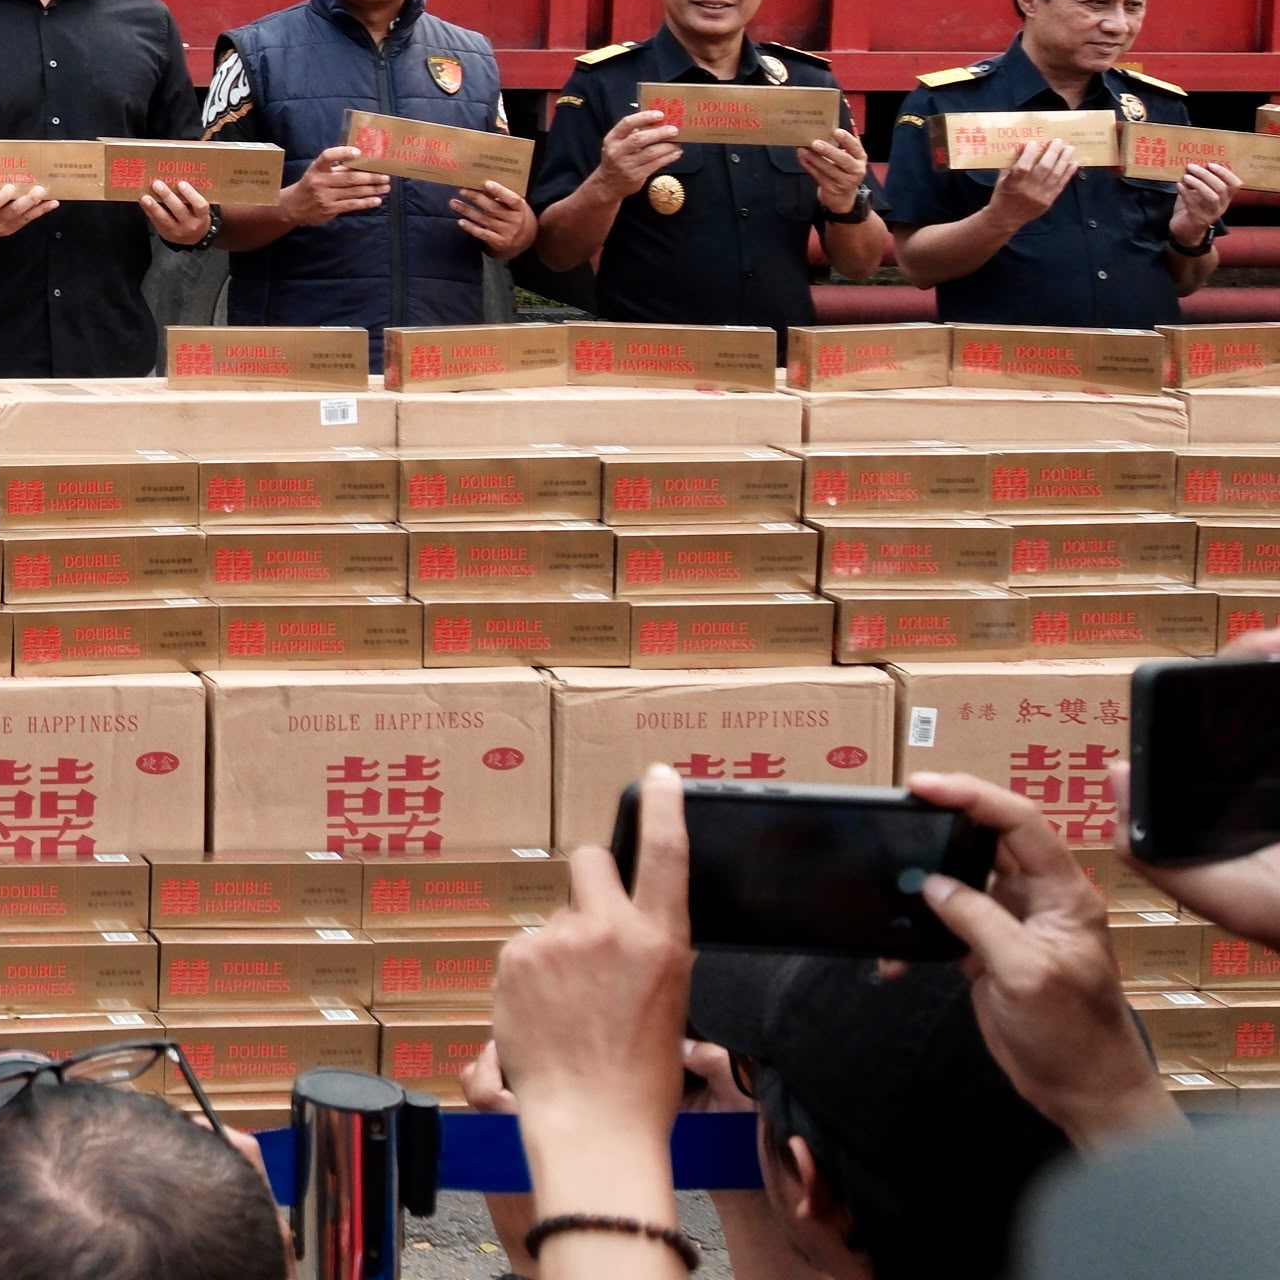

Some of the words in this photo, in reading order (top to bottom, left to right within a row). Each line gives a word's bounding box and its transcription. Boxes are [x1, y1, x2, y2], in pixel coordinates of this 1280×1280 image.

[696, 100, 754, 114] DOUBLE
[688, 115, 763, 130] HAPPINESS
[401, 135, 455, 154] DOUBLE
[389, 148, 460, 171] HAPPINESS
[625, 342, 684, 358] DOUBLE
[617, 358, 695, 374] HAPPINESS
[1039, 467, 1096, 481] DOUBLE
[1031, 483, 1104, 499] HAPPINESS
[62, 553, 120, 569] DOUBLE
[55, 570, 130, 586] HAPPINESS
[690, 620, 749, 635] DOUBLE
[682, 636, 757, 652] HAPPINESS
[636, 710, 708, 729] DOUBLE
[721, 709, 830, 728] HAPPINESS
[958, 703, 996, 722] 香港
[1015, 698, 1129, 726] 紅雙喜
[28, 714, 139, 734] HAPPINESS
[288, 714, 360, 733] DOUBLE
[375, 711, 485, 731] HAPPINESS
[0, 883, 59, 900] DOUBLE
